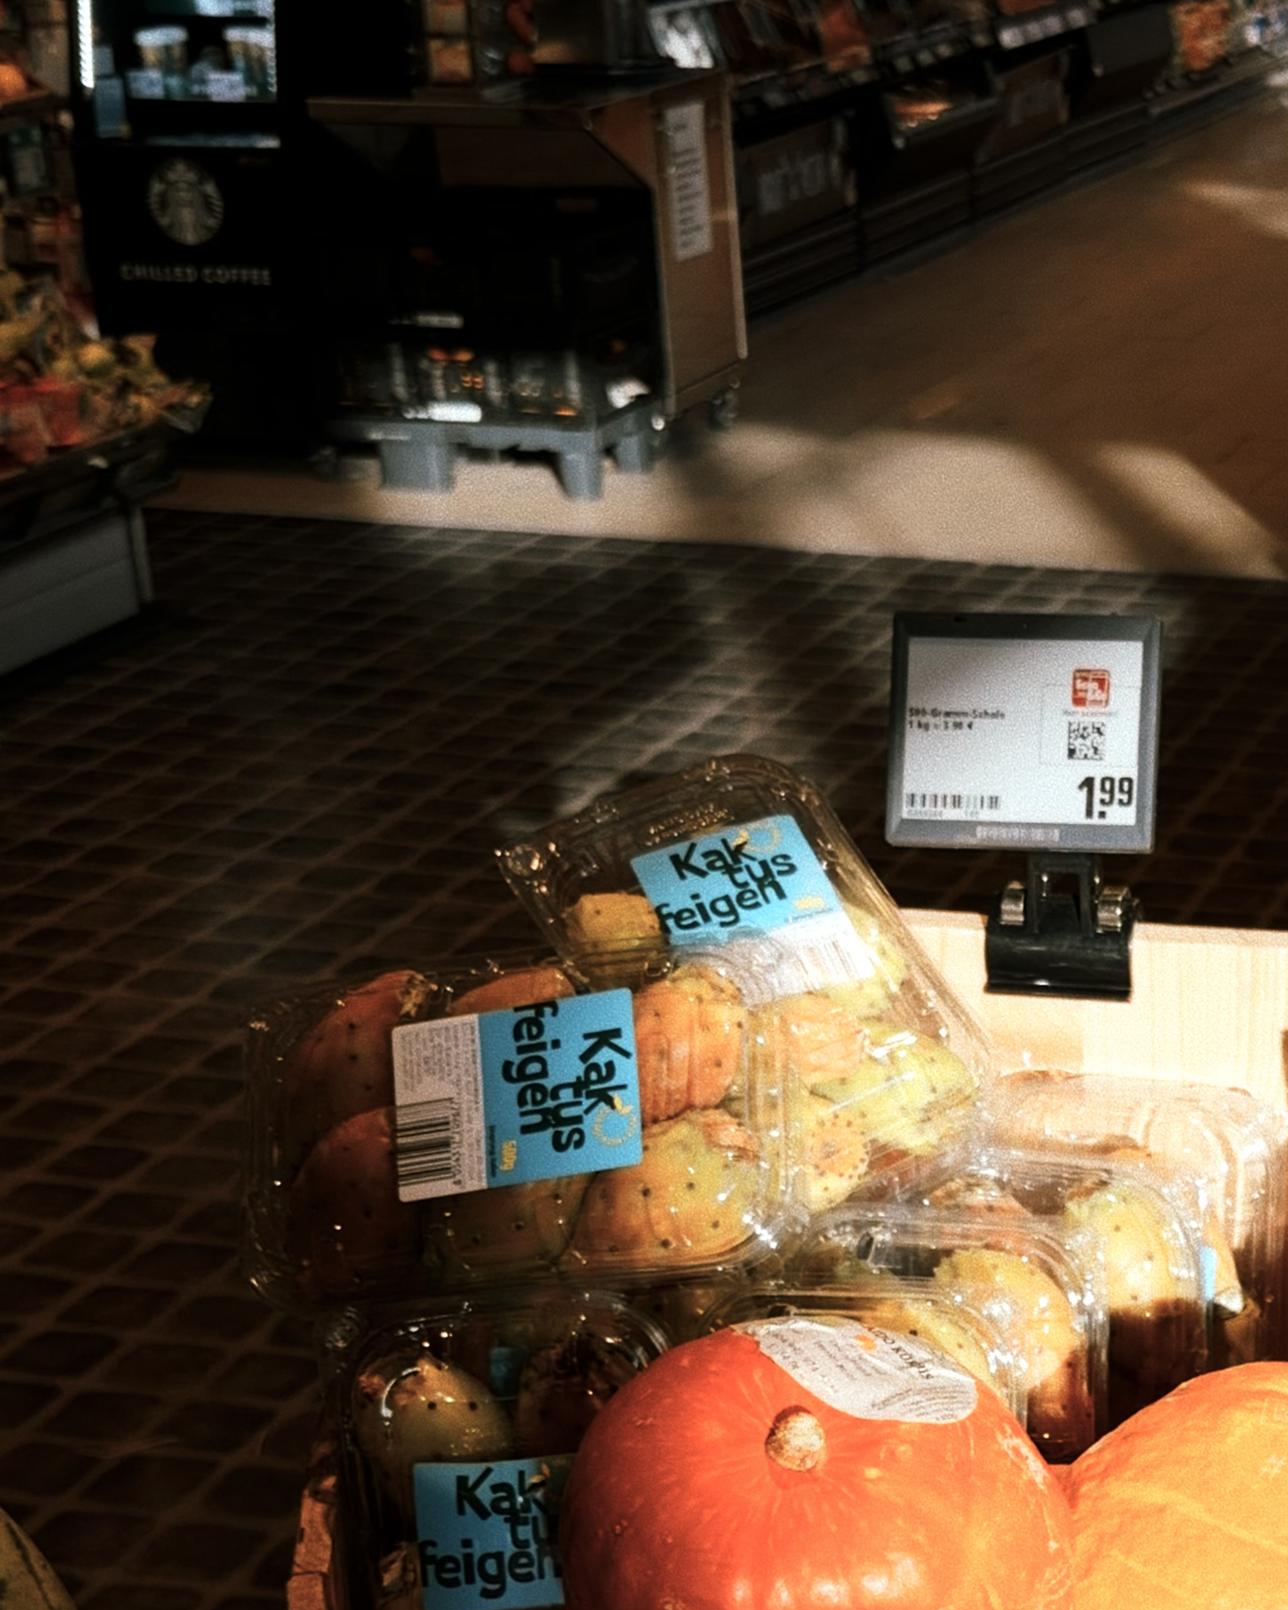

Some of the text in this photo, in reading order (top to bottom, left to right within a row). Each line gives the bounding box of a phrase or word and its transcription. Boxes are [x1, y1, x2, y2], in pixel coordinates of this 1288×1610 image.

[200, 266, 272, 287] COFFEE
[917, 720, 930, 732] kg
[1077, 776, 1134, 819] 1.99
[669, 838, 758, 881] Kak
[722, 853, 798, 890] tus
[655, 875, 788, 936] feigen
[502, 1000, 562, 1135] feigen
[578, 1027, 634, 1116] Kak
[550, 1075, 587, 1153] tus
[456, 1466, 548, 1521] Kak
